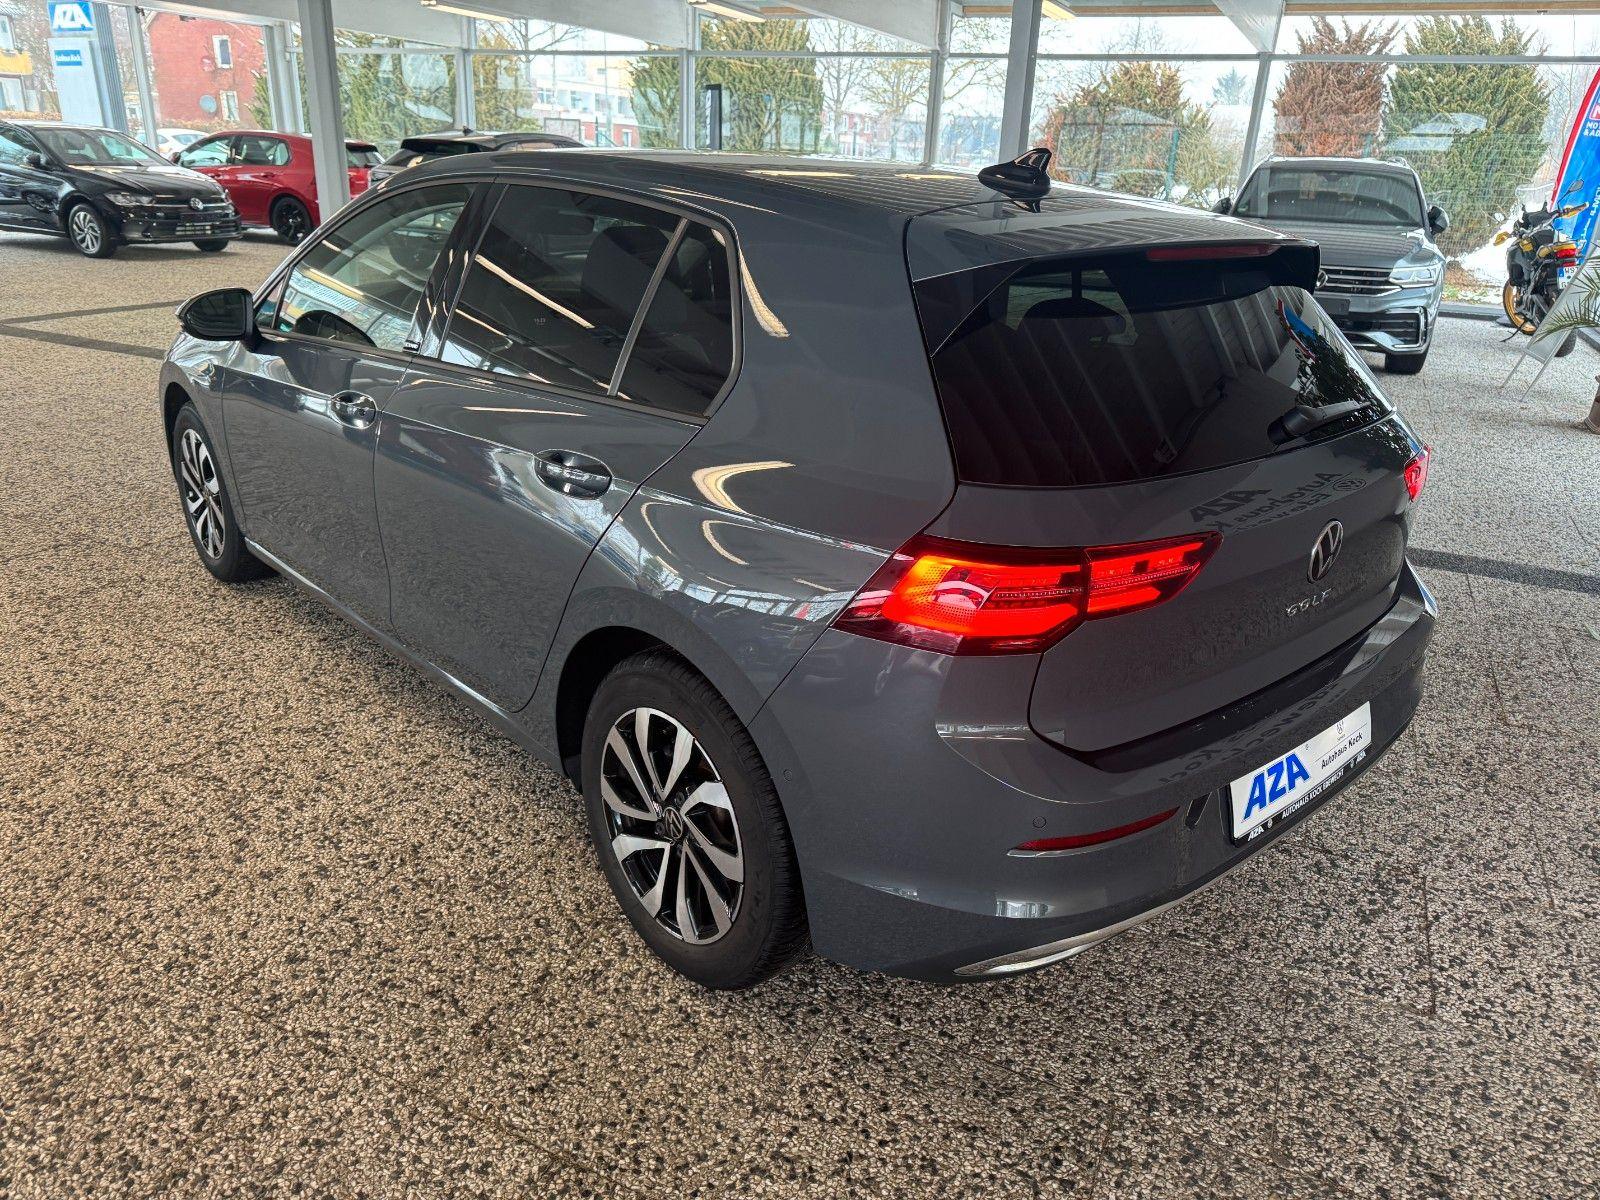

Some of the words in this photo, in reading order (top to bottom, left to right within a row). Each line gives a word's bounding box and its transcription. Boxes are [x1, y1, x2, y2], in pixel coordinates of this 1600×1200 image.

[52, 3, 95, 30] AZA
[1285, 588, 1335, 617] GOLF
[1321, 744, 1348, 769] Autohaus
[1242, 753, 1310, 822] AZA
[1248, 825, 1265, 842] AZA
[1281, 793, 1310, 820] AUTOHAUS
